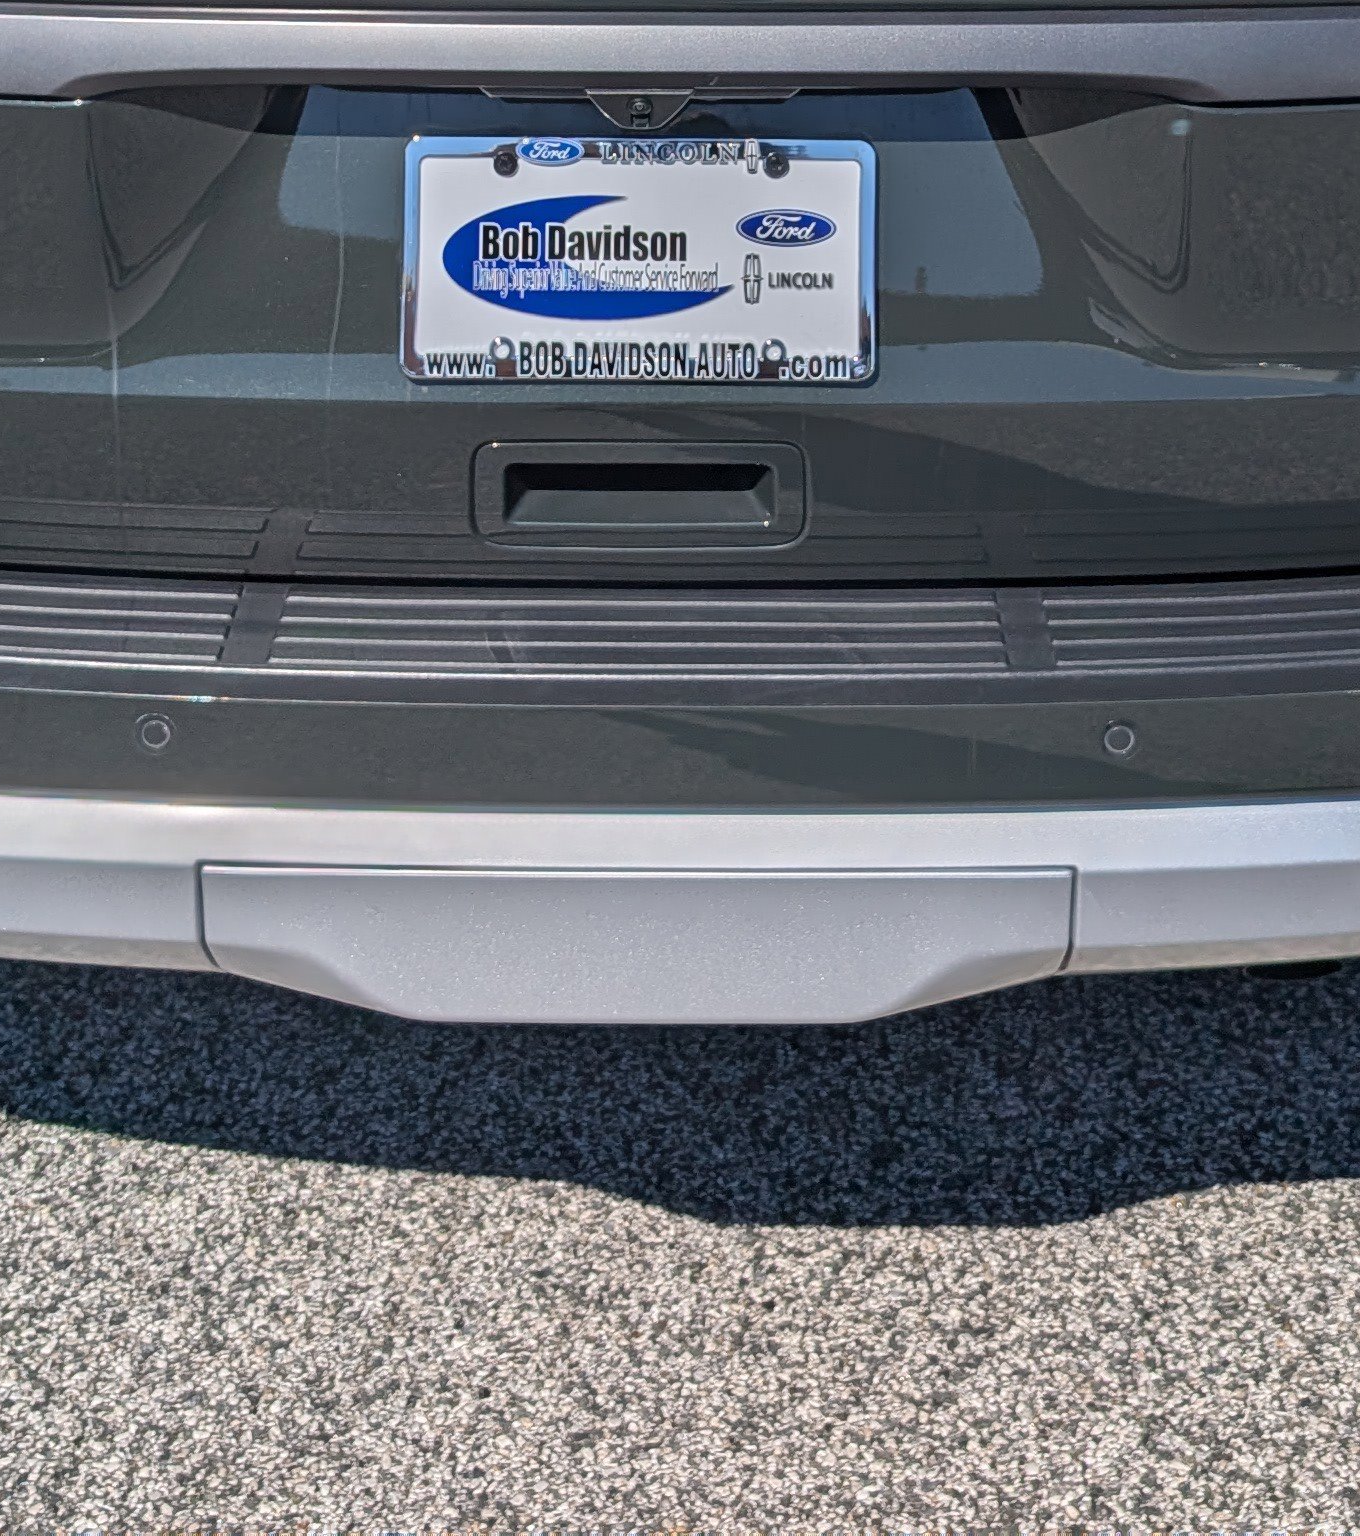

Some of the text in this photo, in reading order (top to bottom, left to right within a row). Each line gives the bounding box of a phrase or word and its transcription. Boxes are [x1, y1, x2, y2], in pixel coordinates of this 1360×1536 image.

[597, 141, 741, 165] LINCOLN
[755, 214, 817, 240] Ford
[481, 224, 687, 262] Bob Davidson
[473, 261, 508, 299] Driving
[508, 261, 550, 299] Superior
[550, 261, 576, 291] Value
[599, 262, 644, 292] Customer
[644, 263, 679, 292] Service
[679, 262, 719, 292] Forward
[768, 272, 833, 289] LINCOLN
[425, 354, 495, 379] www.
[519, 341, 759, 379] BOB DAVIDSON AUTO
[778, 354, 851, 381] .com
